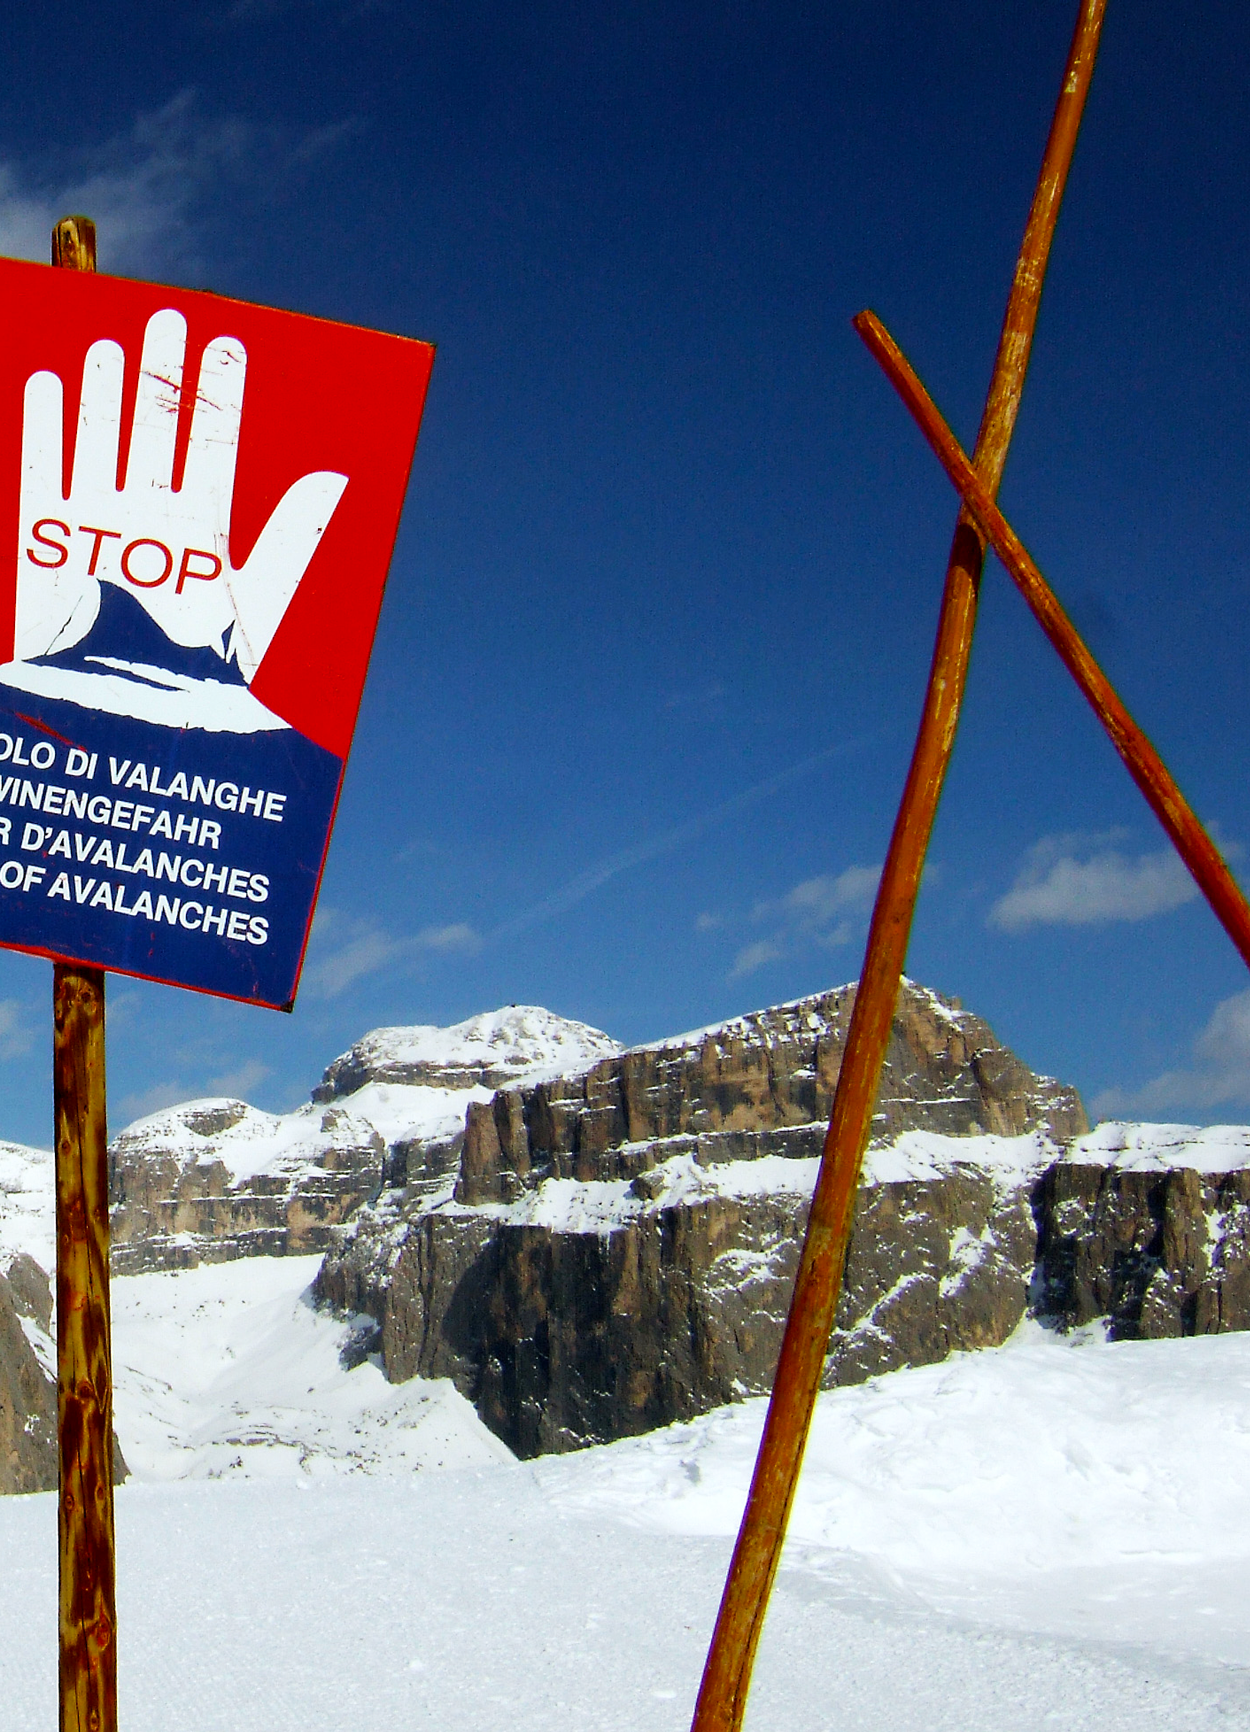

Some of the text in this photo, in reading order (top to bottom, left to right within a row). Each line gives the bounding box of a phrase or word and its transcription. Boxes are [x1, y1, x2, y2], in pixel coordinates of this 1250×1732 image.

[26, 518, 223, 595] STOP
[65, 748, 98, 780] DI
[108, 756, 288, 822] VALANGHE
[21, 822, 270, 902] D'AVALANCHES
[47, 871, 269, 945] AVALANCHES
